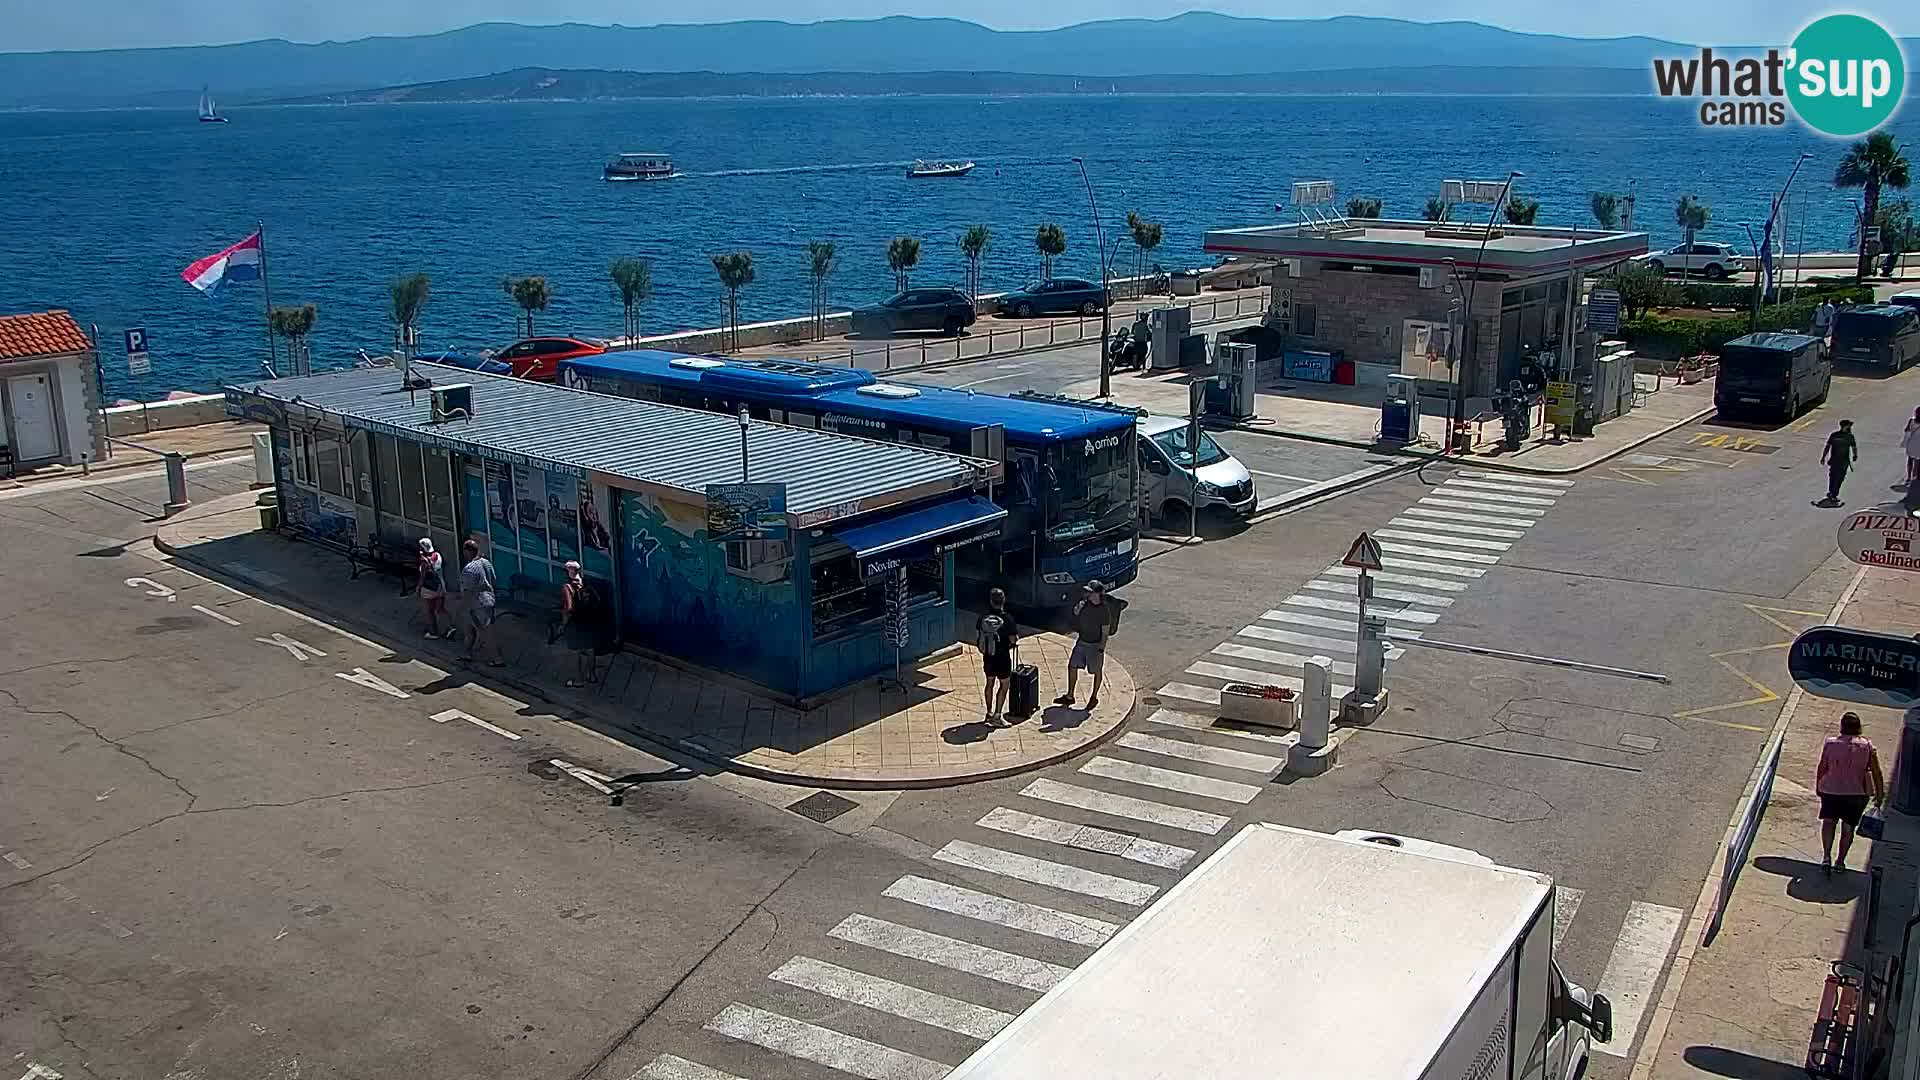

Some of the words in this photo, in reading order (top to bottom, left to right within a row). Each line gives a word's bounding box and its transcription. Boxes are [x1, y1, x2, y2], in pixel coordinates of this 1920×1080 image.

[130, 332, 142, 350] P
[1685, 432, 1761, 451] TAXI
[478, 447, 492, 458] BUS
[494, 450, 526, 465] STATION
[528, 457, 553, 472] TICKET
[555, 464, 581, 478] OFFICE
[1847, 515, 1920, 534] PIZZE
[1871, 665, 1897, 681] bar
